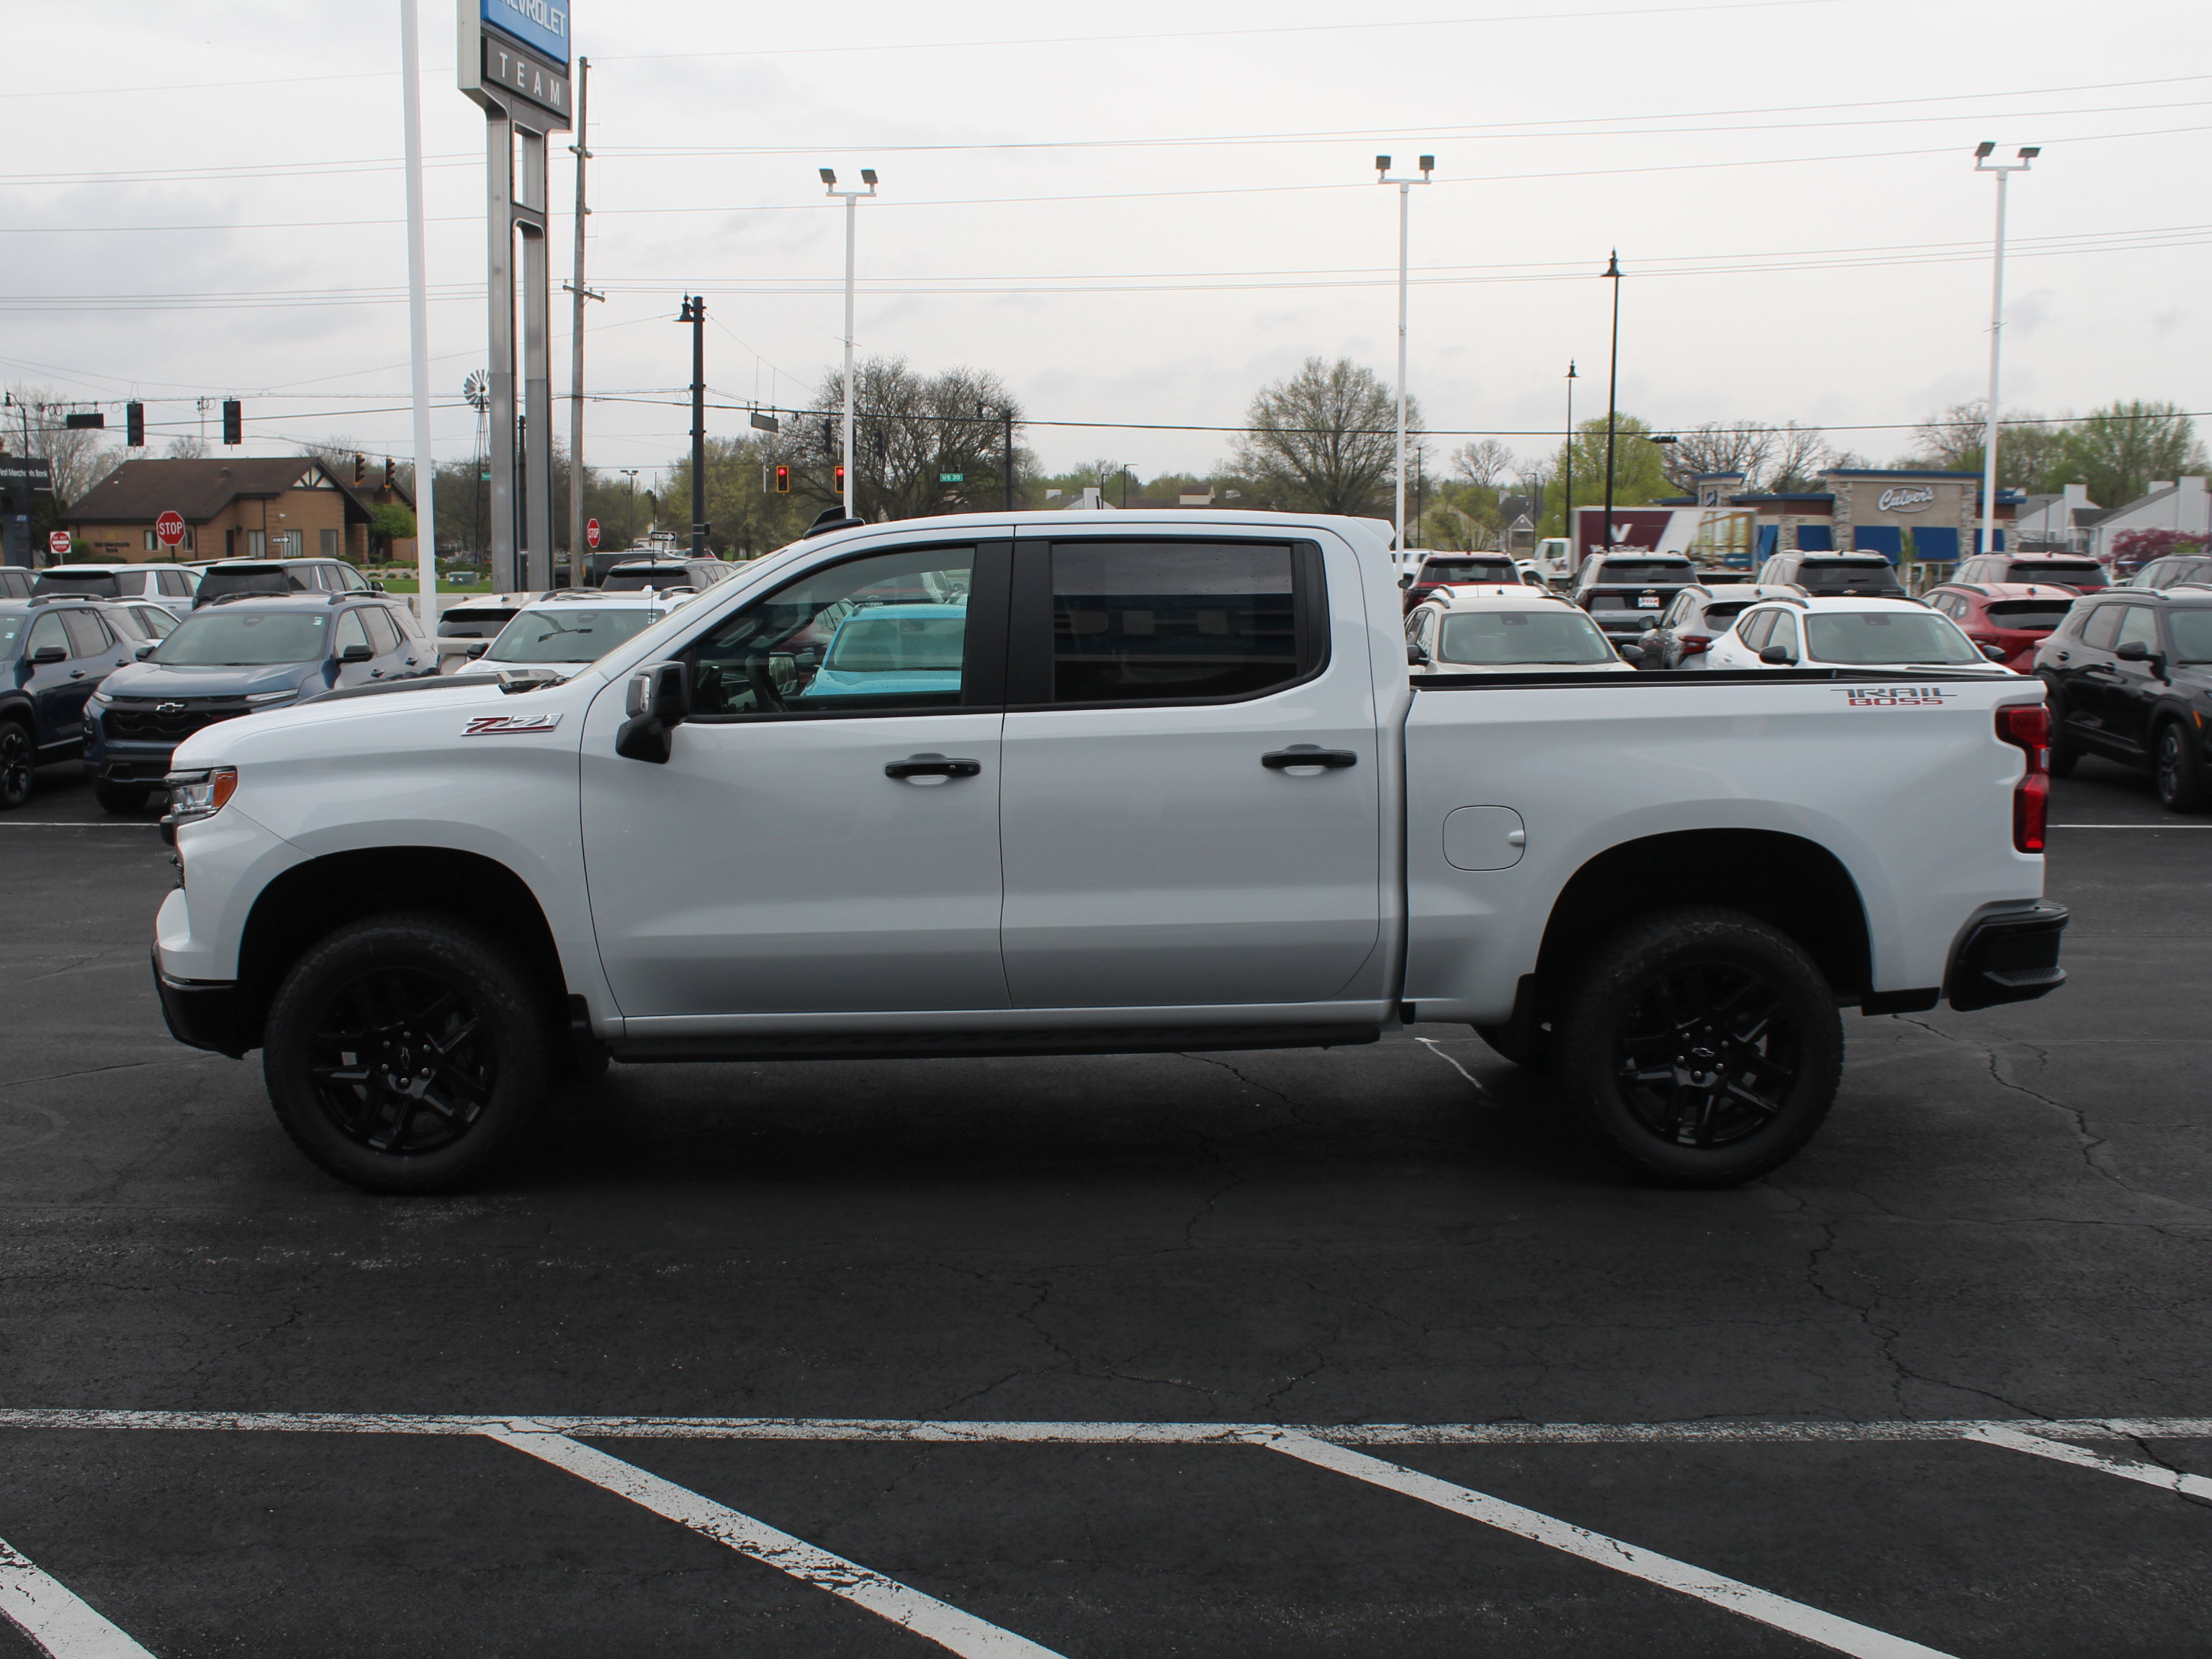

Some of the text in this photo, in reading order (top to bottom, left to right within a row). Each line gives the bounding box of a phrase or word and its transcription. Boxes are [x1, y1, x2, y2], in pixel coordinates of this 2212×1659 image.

[499, 52, 560, 106] TEAM
[1877, 486, 1934, 511] Culver's
[158, 521, 183, 536] STOP
[588, 528, 599, 539] STOP
[1830, 688, 1958, 698] TRAIL
[1848, 697, 1943, 706] BOSS
[461, 713, 564, 737] Z71
